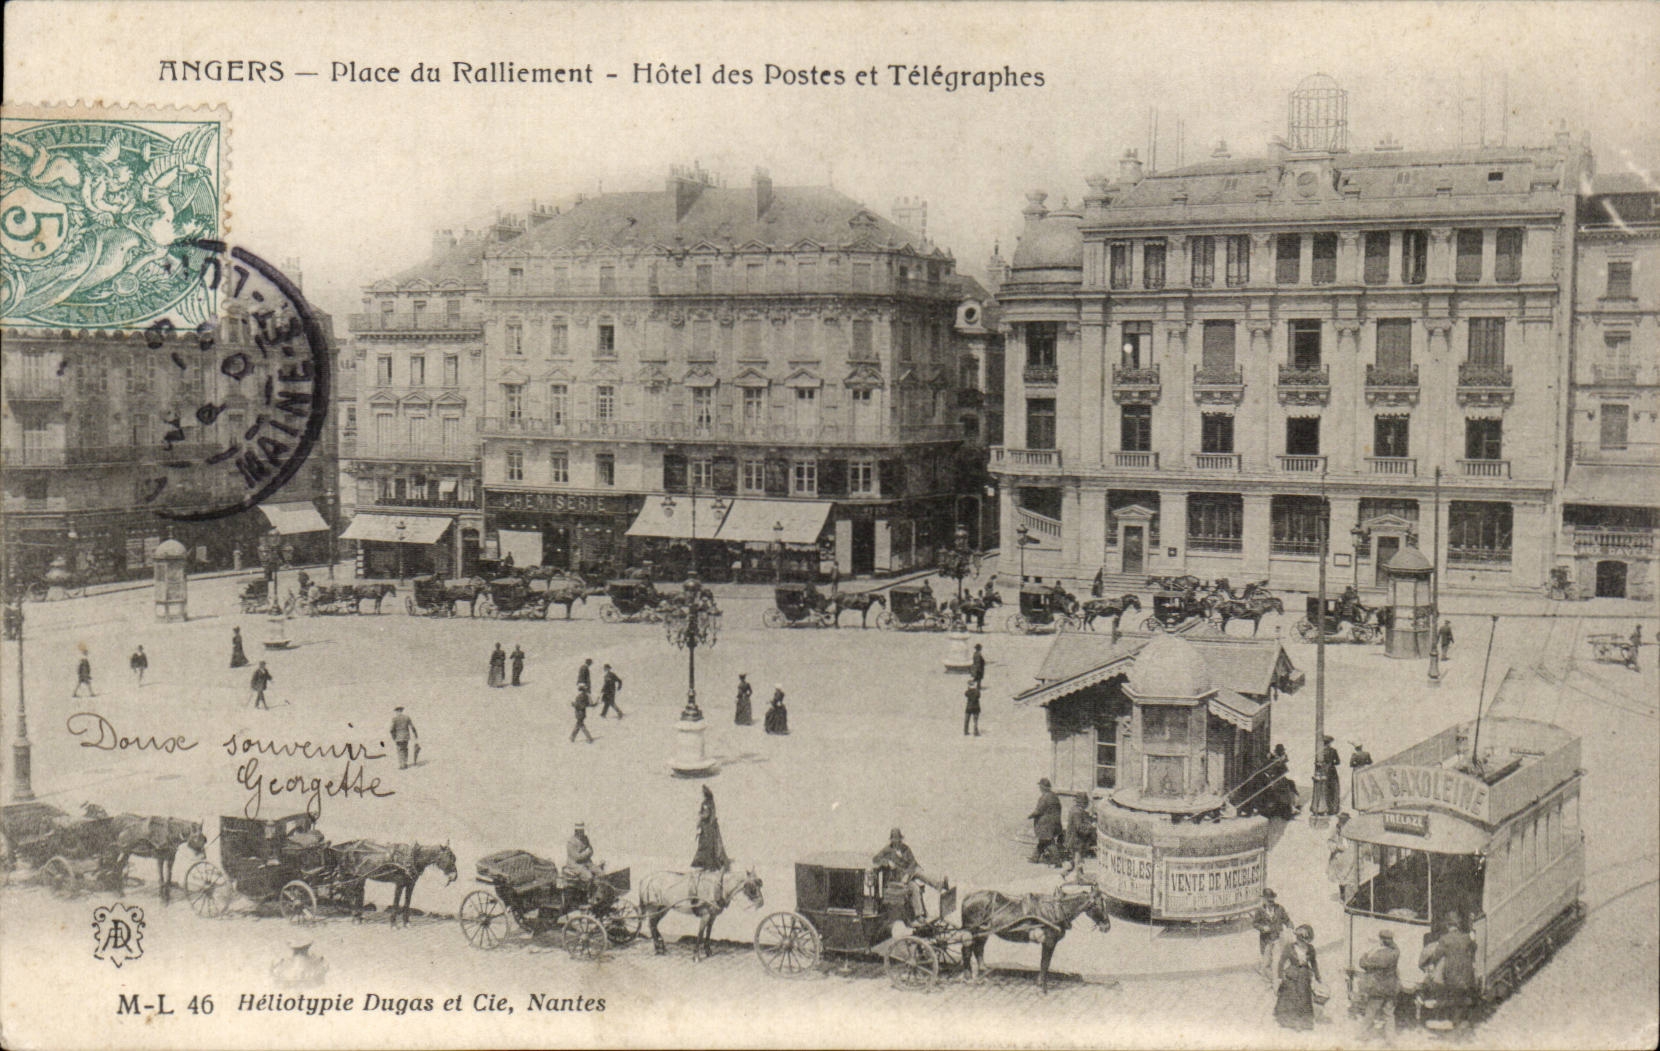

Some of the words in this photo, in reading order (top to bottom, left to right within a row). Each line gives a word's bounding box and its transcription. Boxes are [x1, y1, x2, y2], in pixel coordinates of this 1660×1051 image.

[236, 757, 396, 820] Georgette
[1171, 872, 1205, 892] VENTE
[1208, 871, 1221, 891] DE
